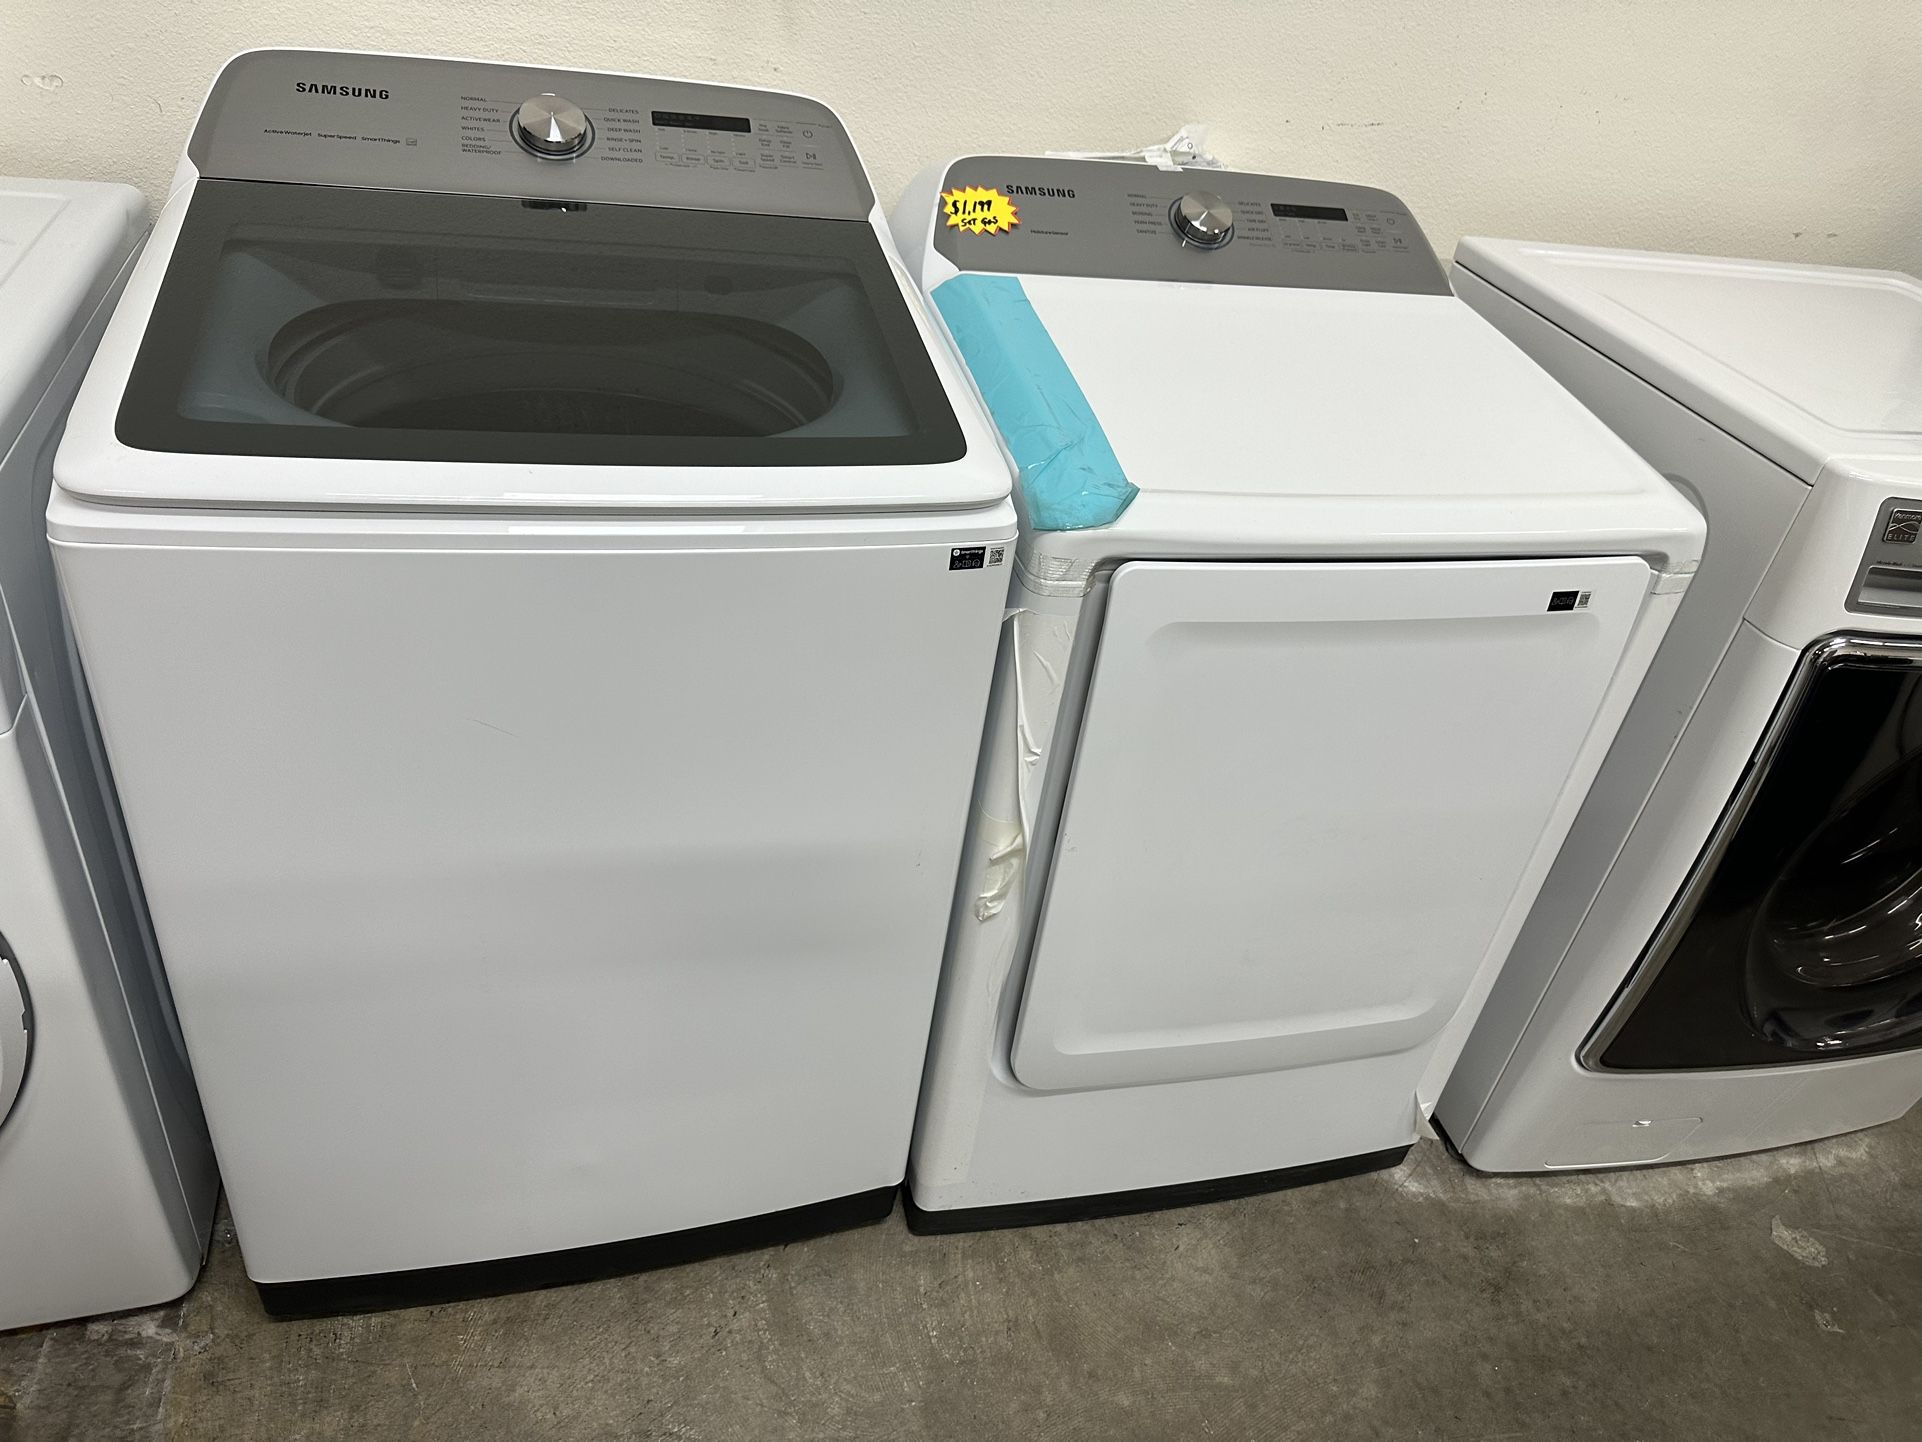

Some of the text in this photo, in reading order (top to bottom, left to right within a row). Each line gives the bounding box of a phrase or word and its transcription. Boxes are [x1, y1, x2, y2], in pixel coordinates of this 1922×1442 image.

[296, 82, 390, 100] SAMSUNG
[460, 95, 487, 103] NORMAL
[460, 105, 482, 113] HEAVY
[608, 107, 640, 115] DELICATES
[461, 115, 501, 123] ACTIVEWEAR
[462, 148, 502, 156] WATERPROOF
[600, 155, 643, 164] DOWNLOADED
[1006, 184, 1076, 199] SAMSUNG
[949, 199, 993, 216] $1,199
[1887, 533, 1915, 541] ELITE
